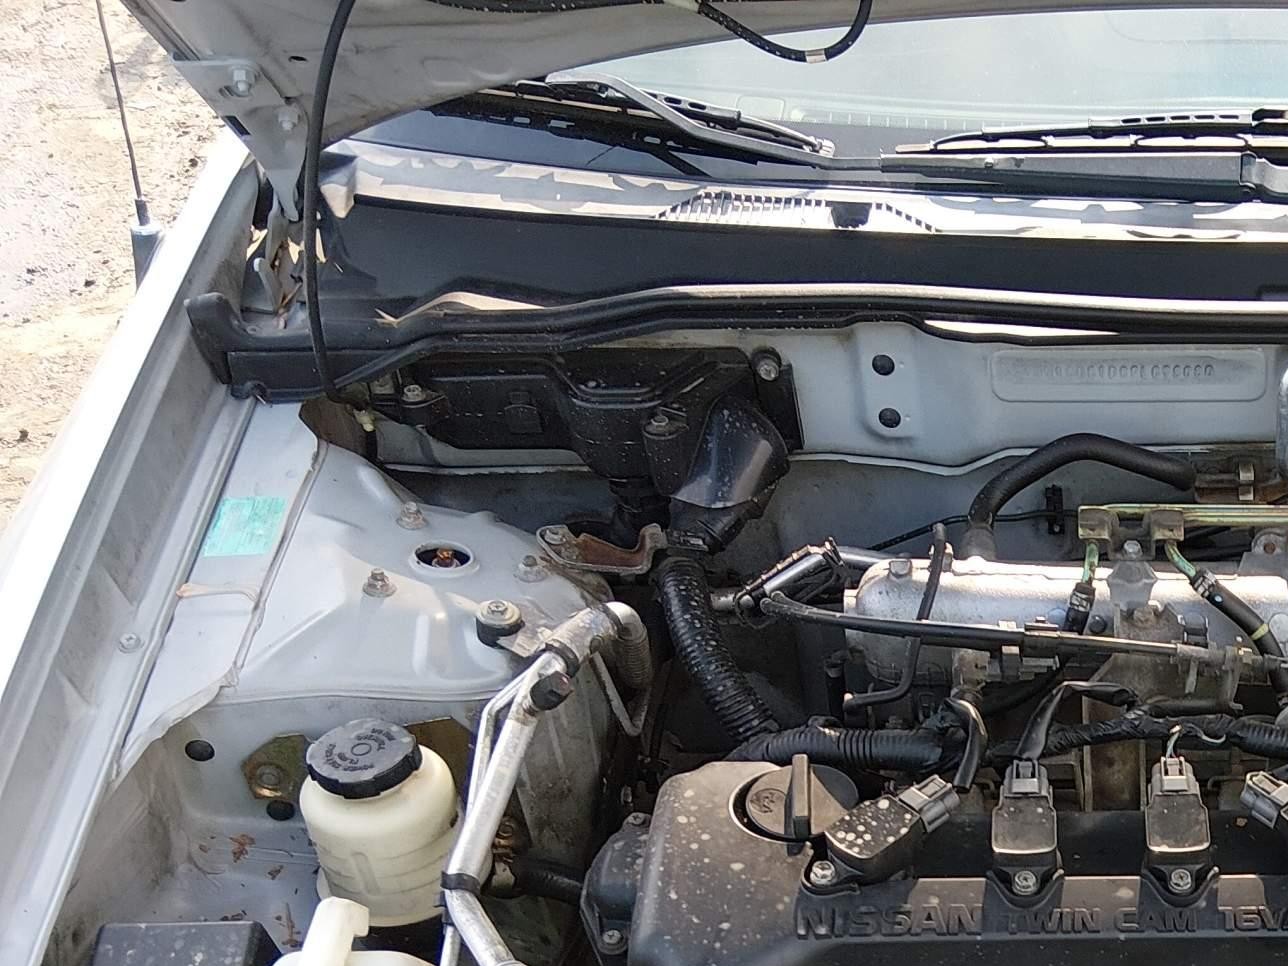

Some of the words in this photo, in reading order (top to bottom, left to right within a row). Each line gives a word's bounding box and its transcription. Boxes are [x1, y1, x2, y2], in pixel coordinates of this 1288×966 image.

[796, 903, 982, 939] NISSAN
[1007, 907, 1100, 934] TWIN
[1115, 906, 1198, 933] CAM
